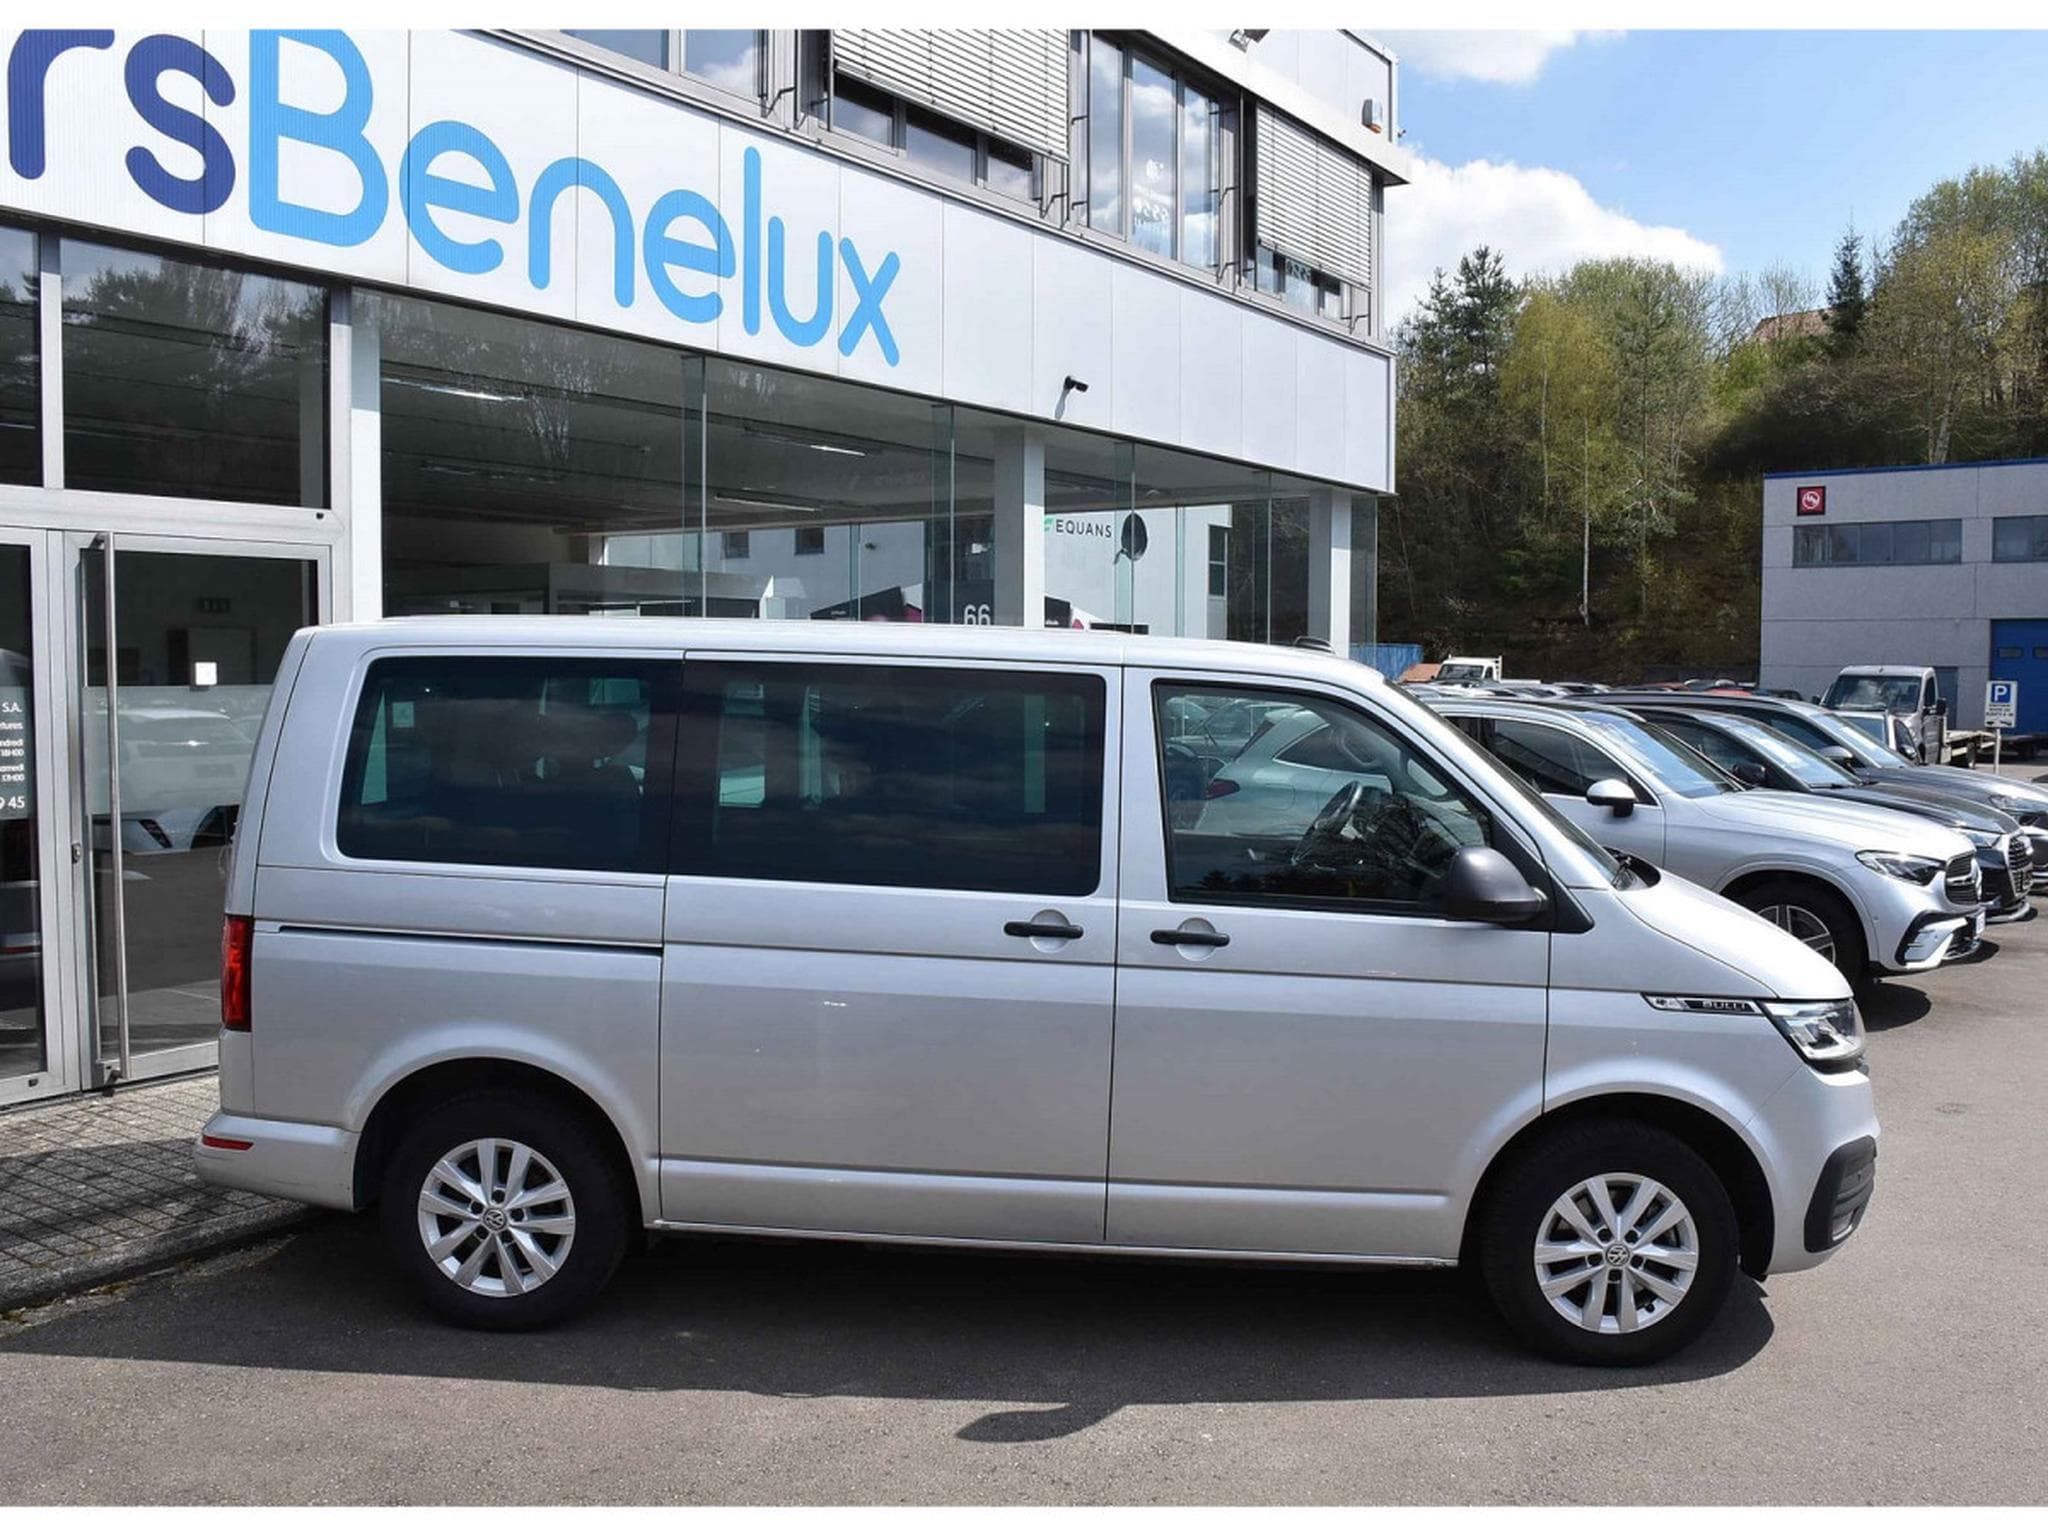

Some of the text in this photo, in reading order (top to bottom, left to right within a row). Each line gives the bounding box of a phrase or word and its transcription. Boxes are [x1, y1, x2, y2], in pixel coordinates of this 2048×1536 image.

[1055, 519, 1112, 538] EQUANS
[1994, 685, 2007, 701] P
[8, 796, 25, 809] 45
